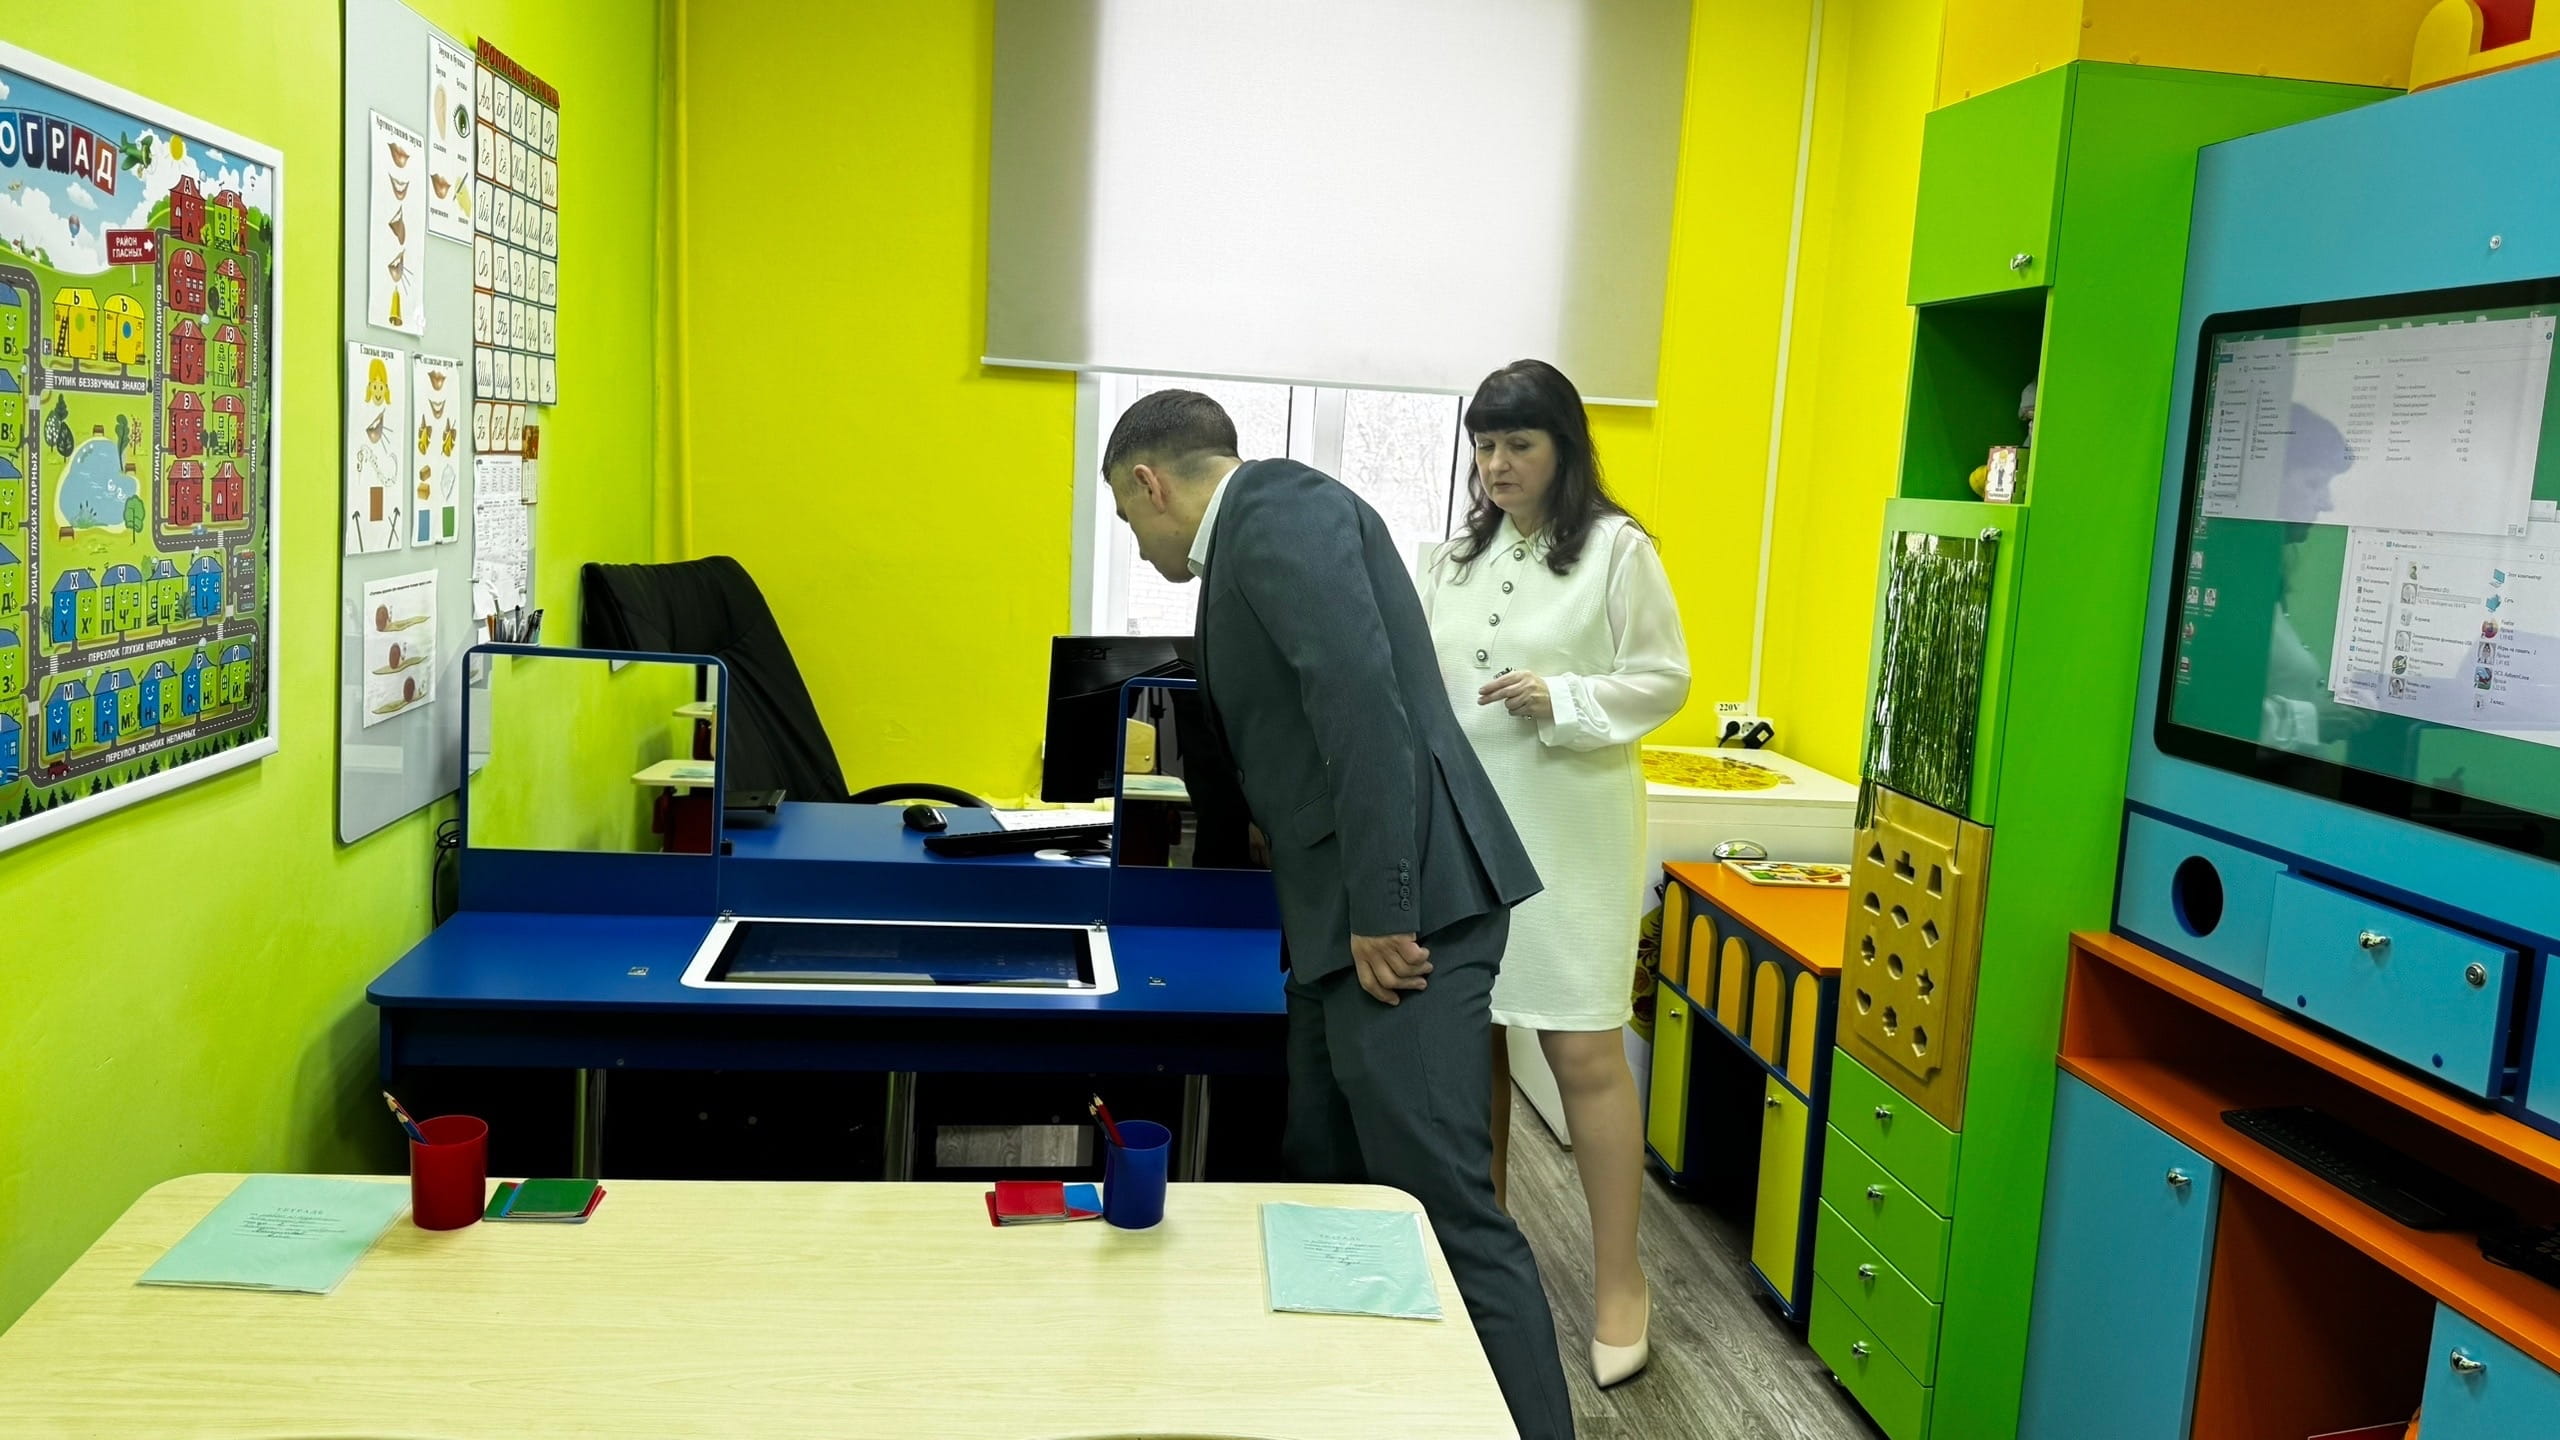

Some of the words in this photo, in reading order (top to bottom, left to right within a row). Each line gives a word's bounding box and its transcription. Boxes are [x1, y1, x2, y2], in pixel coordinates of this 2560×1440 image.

[0, 120, 112, 189] ОГРАД
[185, 179, 191, 194] А
[116, 236, 137, 246] РАЙОН
[113, 248, 142, 257] ГЛАСНЫХ
[54, 376, 76, 387] ТУПИК
[79, 377, 120, 390] БЕЗЗВУЧНЫХ
[122, 380, 146, 391] ЗНАКОВ
[88, 649, 120, 663] ПЕРЕУЛОК
[122, 643, 144, 656] ГЛУХИХ
[146, 637, 177, 650] НЕПАРНЫХ
[64, 683, 73, 700] М
[1719, 703, 1741, 712] 220V
[105, 746, 136, 763] ПЕРЕУЛОК
[137, 737, 165, 753] ЗВОНКИХ
[166, 728, 196, 744] НЕПАРНЫХ
